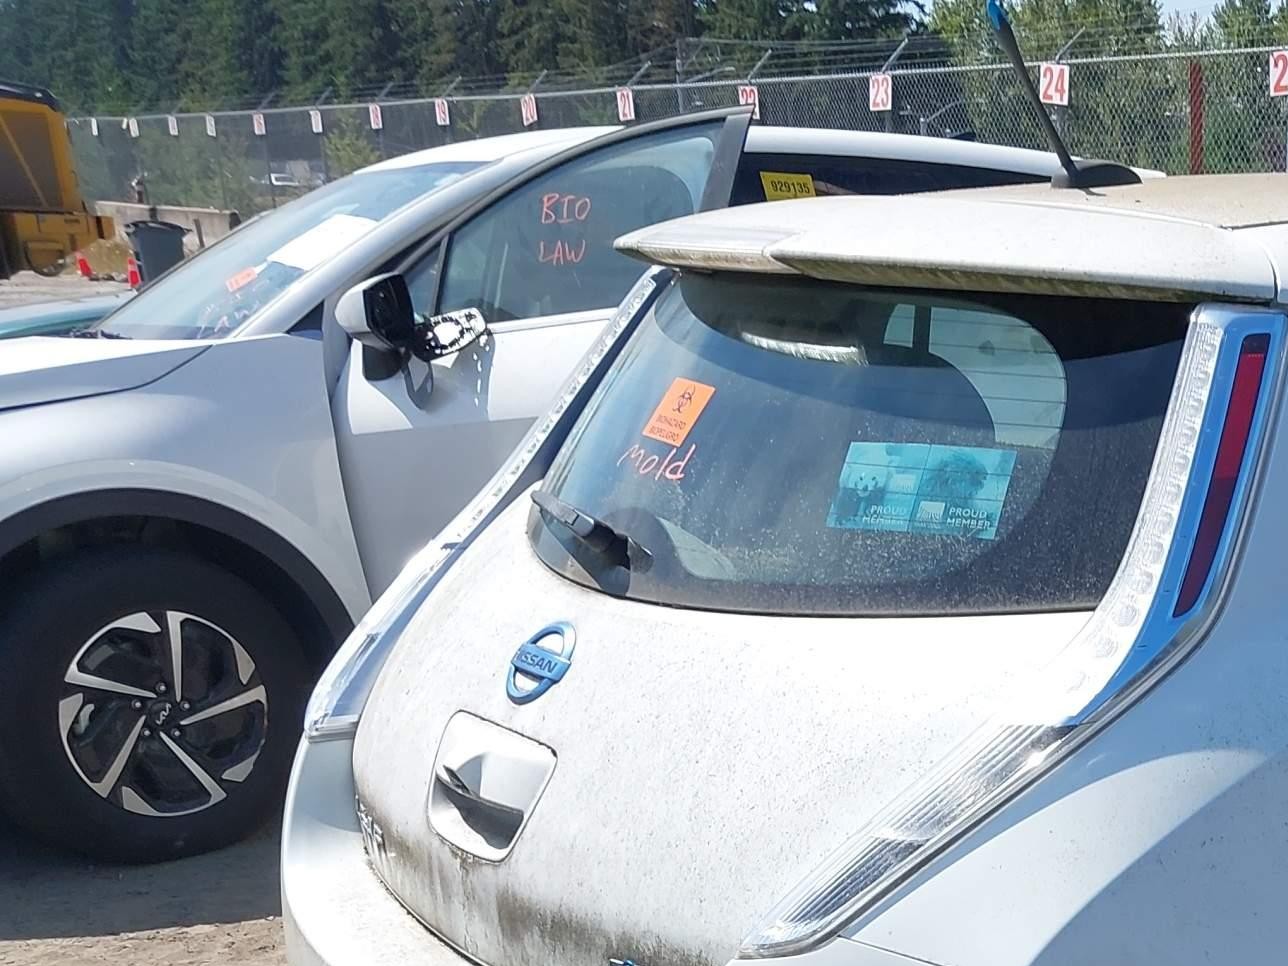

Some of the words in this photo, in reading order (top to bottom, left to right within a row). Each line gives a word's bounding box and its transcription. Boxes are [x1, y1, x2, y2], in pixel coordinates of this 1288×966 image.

[871, 76, 890, 109] 23
[1042, 66, 1067, 103] 24
[522, 96, 535, 122] 20
[619, 89, 633, 119] 21
[770, 180, 811, 195] 929135
[540, 192, 592, 225] BIO
[537, 239, 587, 266] LAW
[870, 504, 907, 516] PROUD
[948, 507, 989, 519] PROUD
[945, 518, 993, 530] MEMBER
